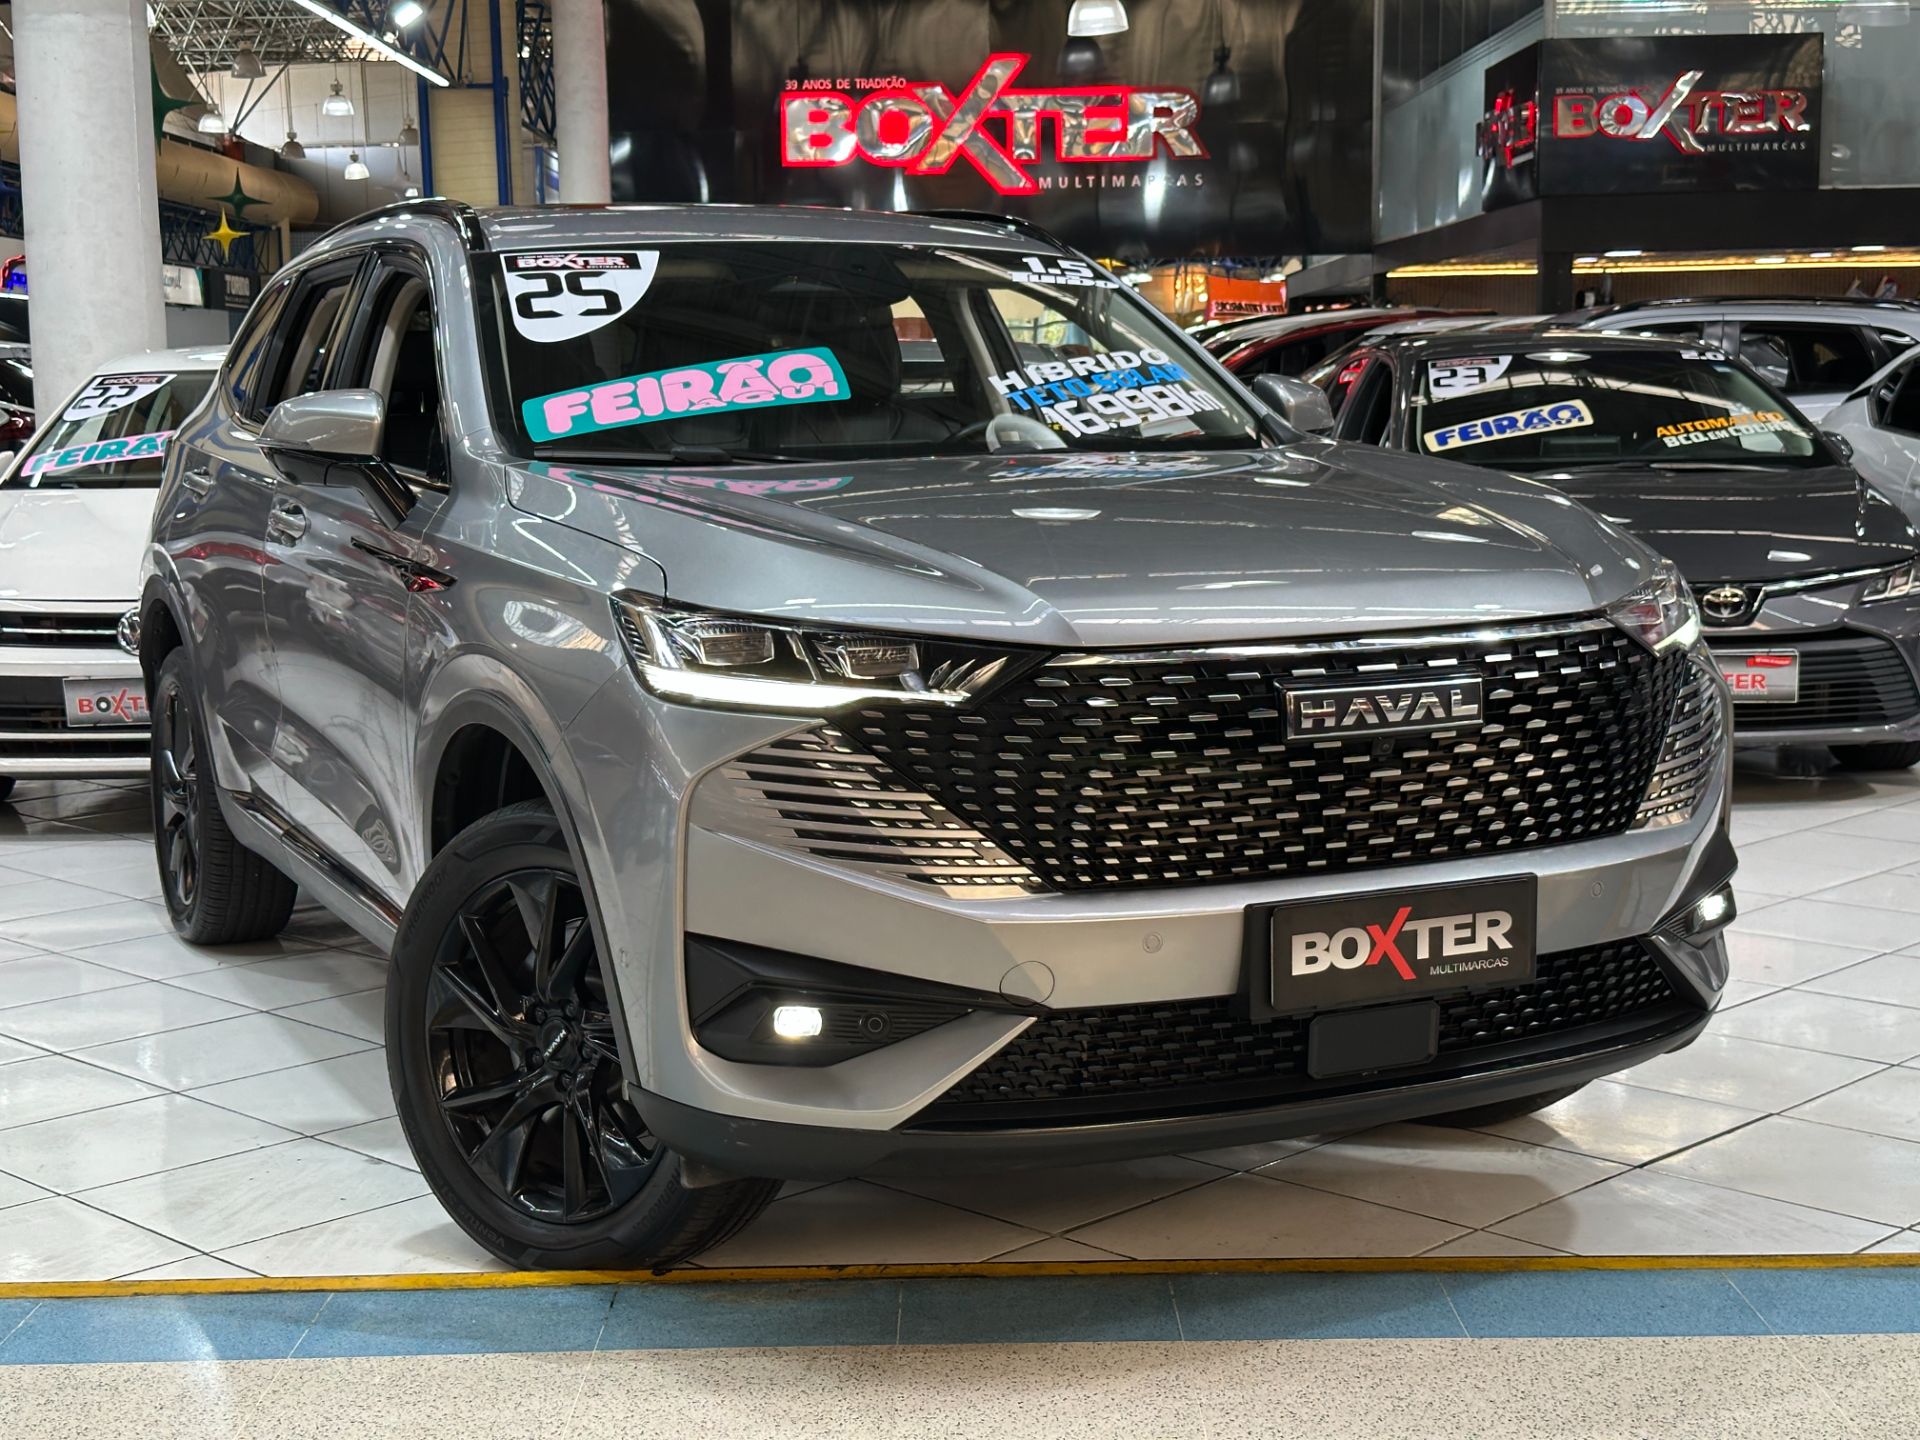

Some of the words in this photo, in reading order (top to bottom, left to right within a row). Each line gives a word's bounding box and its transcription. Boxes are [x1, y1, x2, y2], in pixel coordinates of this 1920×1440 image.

[785, 80, 798, 90] 39
[802, 79, 832, 90] ANOS
[836, 79, 850, 90] DE
[855, 76, 906, 90] TRADIÇÃO
[1553, 69, 1811, 154] BOXTER
[780, 52, 1210, 195] BOXTER
[1706, 141, 1806, 153] MULTIMARCAS
[516, 253, 627, 269] BOXTER
[1021, 256, 1094, 278] 1.5
[515, 271, 622, 319] 25
[1680, 350, 1725, 361] 2.0
[103, 376, 158, 385] BOXTER
[1006, 378, 1094, 411] TETO
[1092, 361, 1191, 393] SOLAR
[1433, 367, 1487, 387] 23
[72, 385, 138, 410] 22
[543, 353, 835, 434] FEIRÃO
[1434, 404, 1582, 447] FEIRÃO
[1707, 429, 1730, 441] EM
[1300, 689, 1478, 729] HAVAL
[1291, 906, 1514, 980] BOXTER
[1429, 956, 1510, 976] MULTIMARCAS
